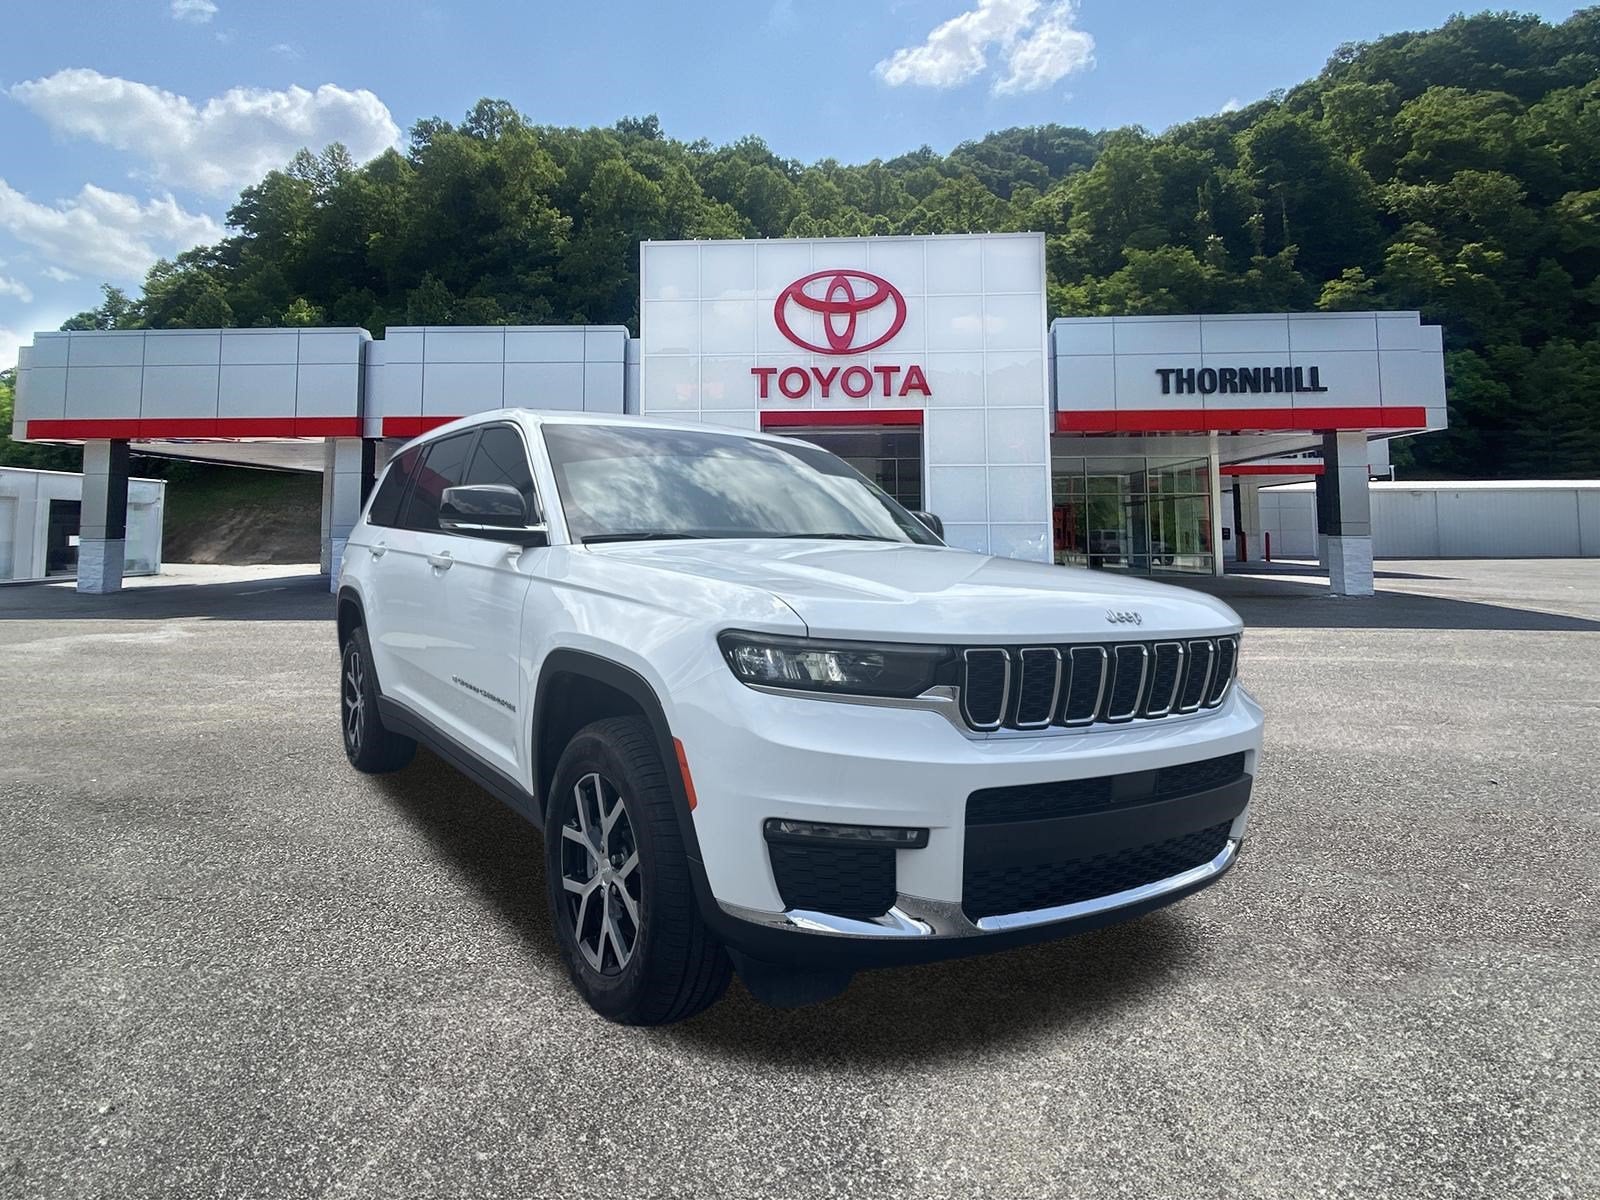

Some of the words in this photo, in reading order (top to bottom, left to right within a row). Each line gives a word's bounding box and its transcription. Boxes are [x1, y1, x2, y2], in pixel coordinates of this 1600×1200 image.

[751, 365, 932, 399] TOYOTA
[1155, 366, 1329, 395] THORNHILL
[1105, 608, 1142, 626] Jeep
